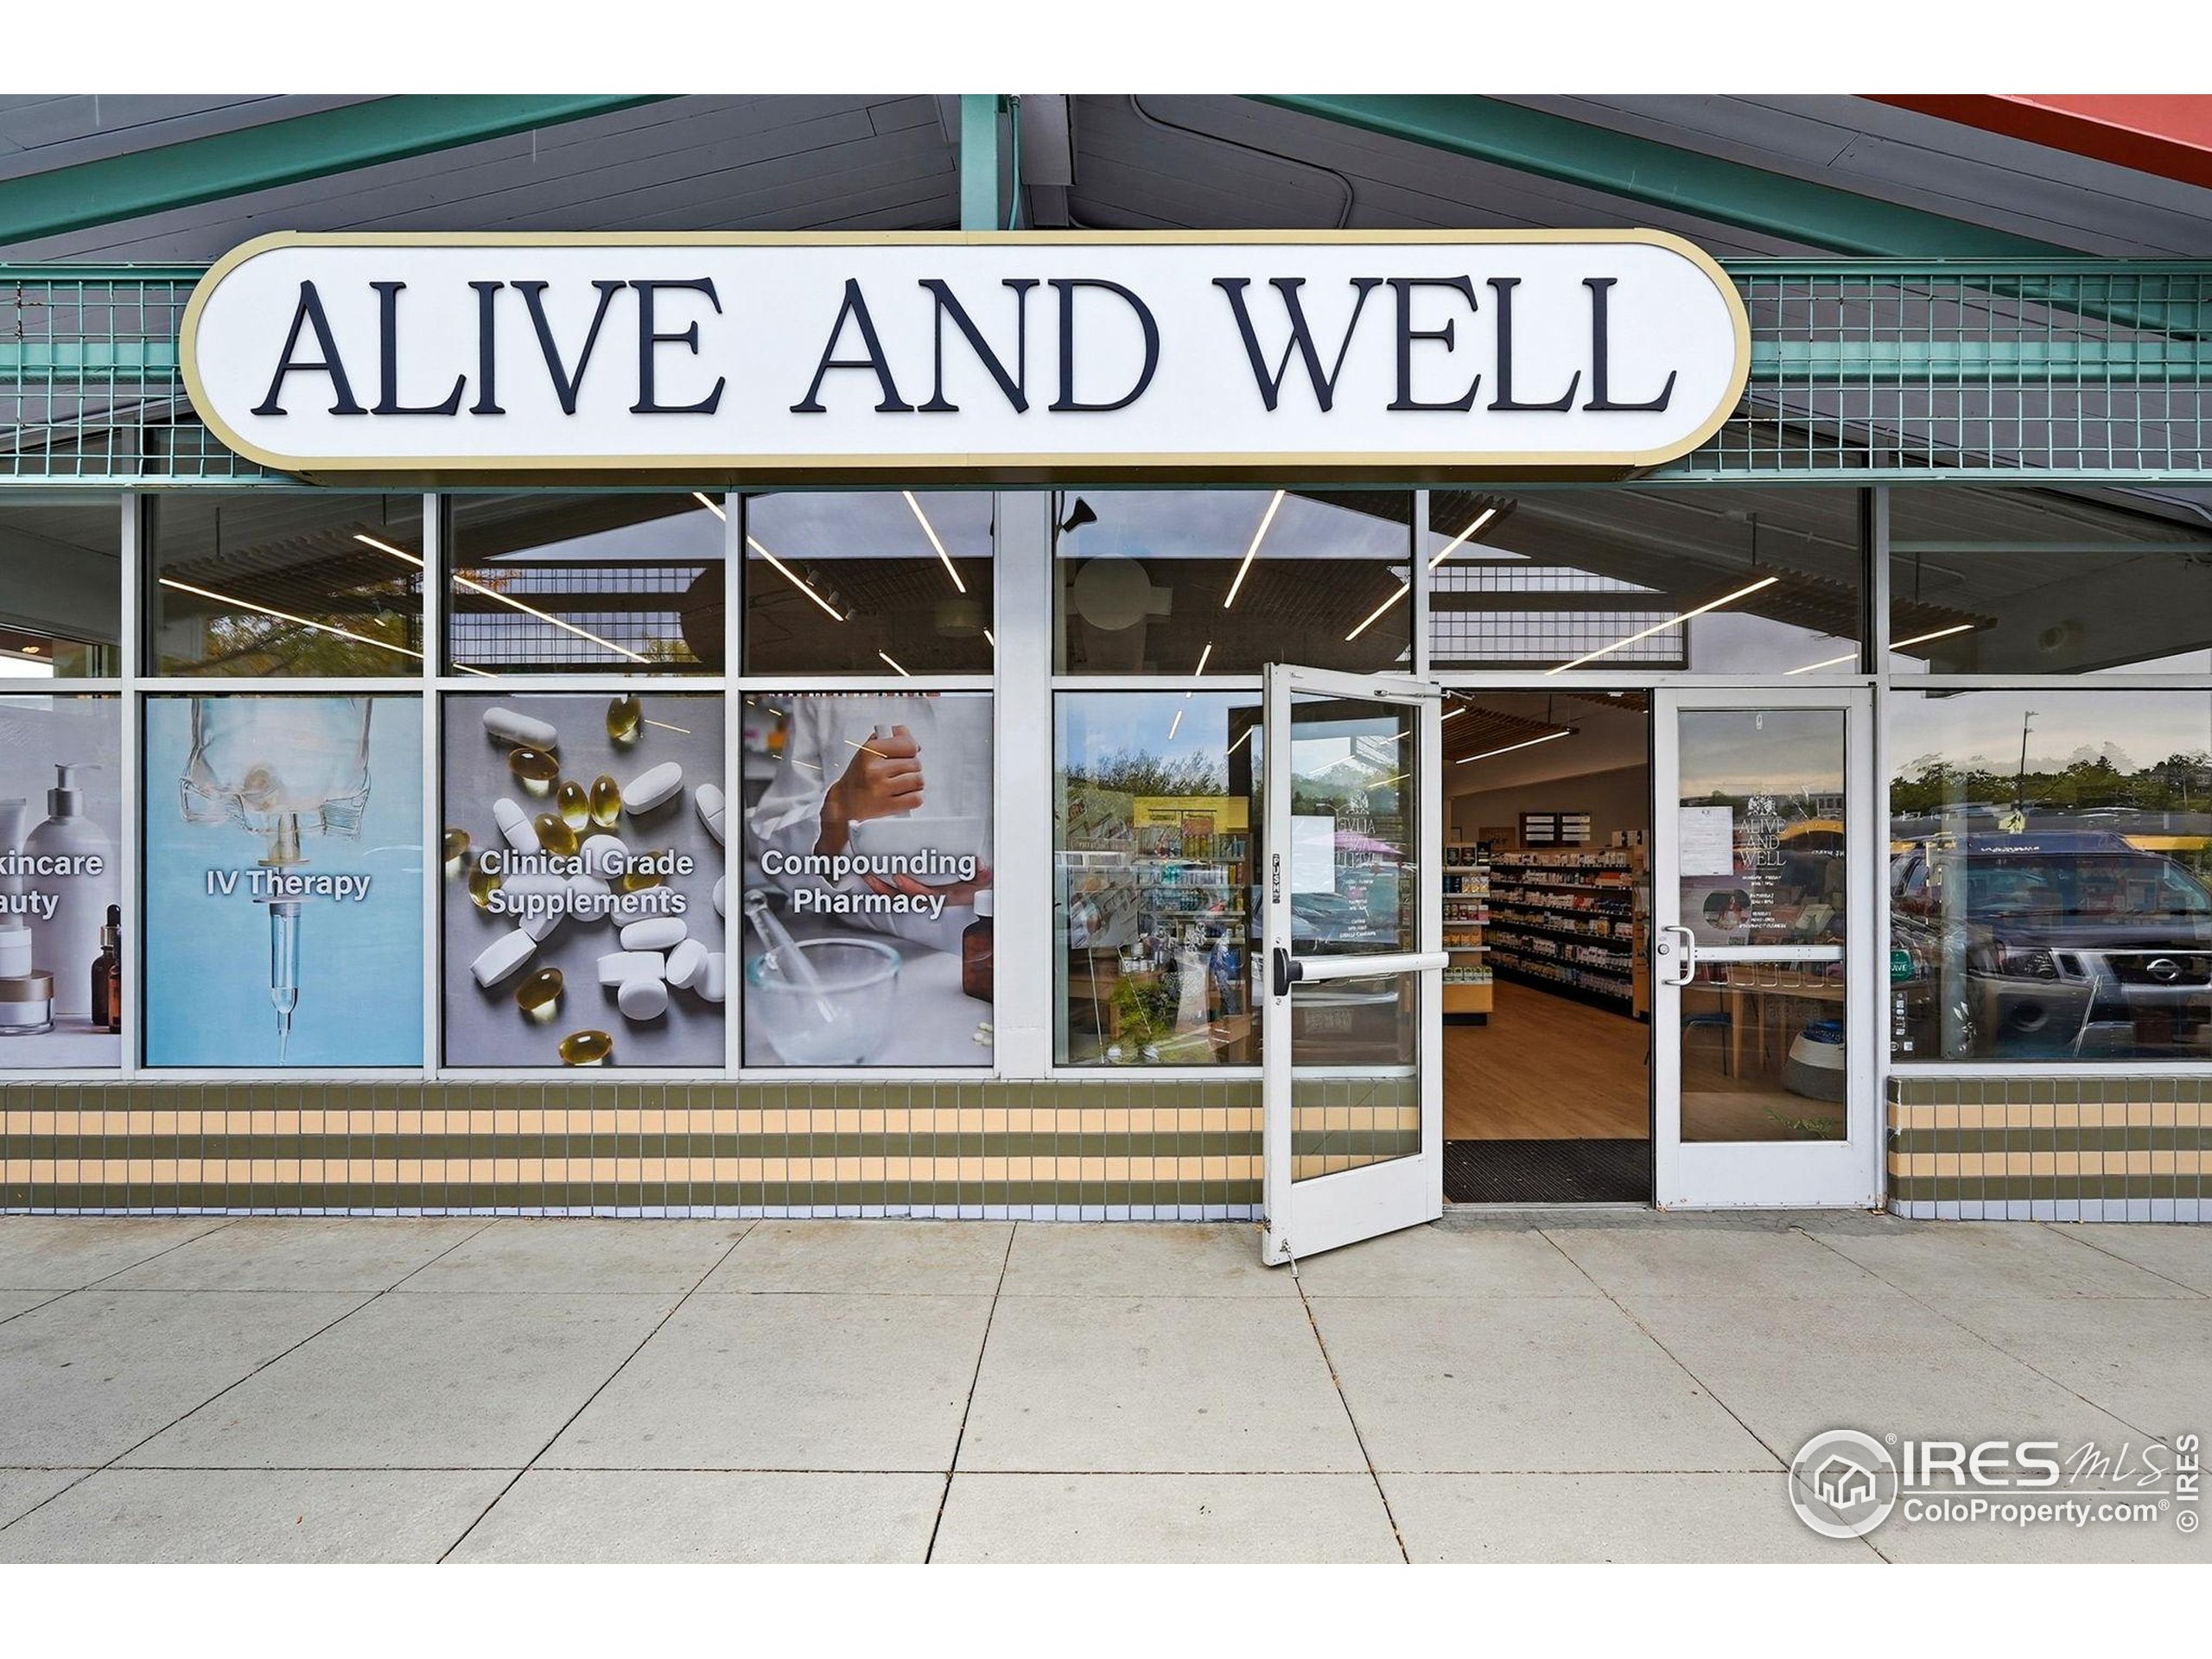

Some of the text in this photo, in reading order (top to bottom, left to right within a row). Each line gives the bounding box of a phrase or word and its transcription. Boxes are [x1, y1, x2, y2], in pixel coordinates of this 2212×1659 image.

[251, 275, 1677, 416] ALIVE AND WELL
[1738, 818, 1787, 834] ALIVE
[1747, 834, 1780, 850] AND
[480, 849, 694, 875] Clinical Grade
[760, 849, 977, 882] Compounding
[1739, 850, 1787, 866] WELL
[207, 869, 371, 901] IV Therapy
[486, 889, 688, 919] Supplements
[793, 888, 946, 919] Pharmacy
